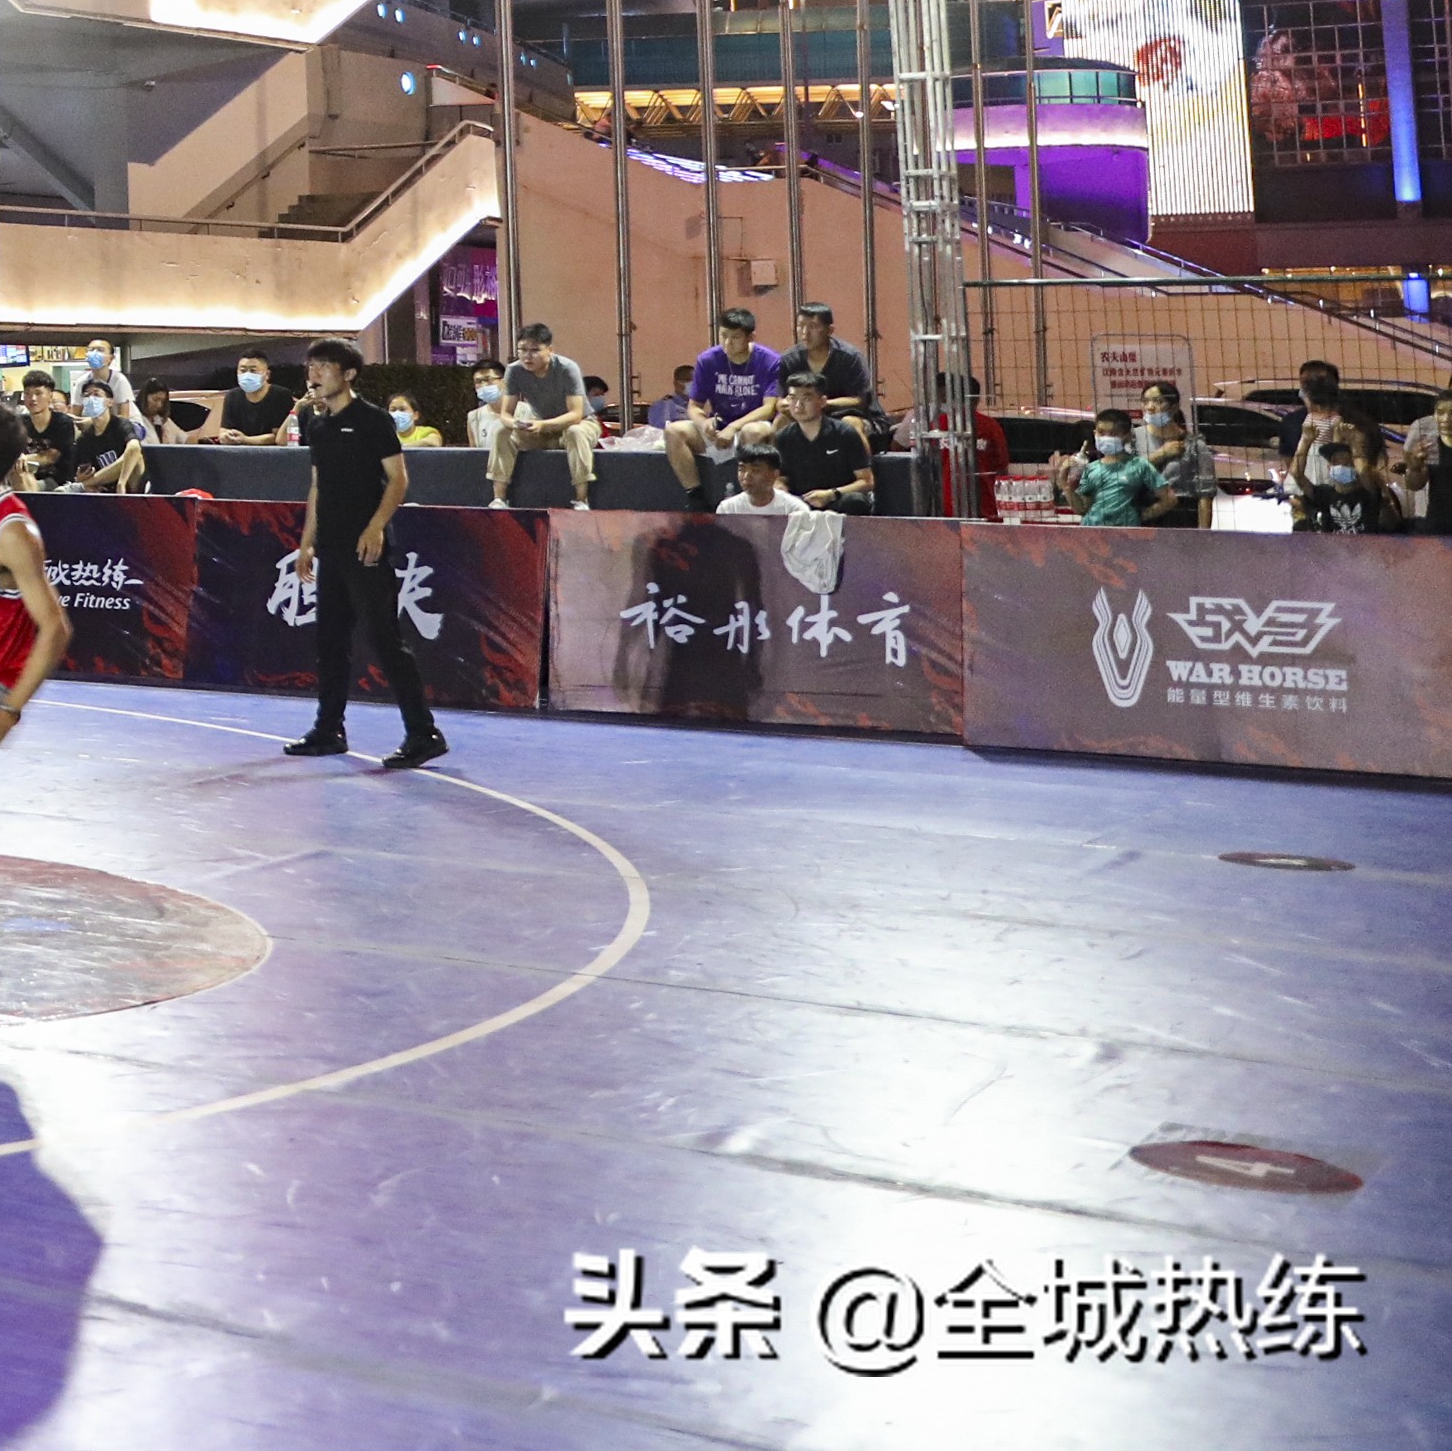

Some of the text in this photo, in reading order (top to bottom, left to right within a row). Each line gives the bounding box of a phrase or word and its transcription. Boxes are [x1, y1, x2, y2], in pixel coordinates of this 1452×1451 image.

[42, 557, 144, 591] 城热练
[73, 592, 131, 610] Fitness
[619, 582, 911, 668] 裕彤体育
[1165, 659, 1349, 691] WAR HORSE
[1166, 686, 1348, 714] 能量型维生素饮料
